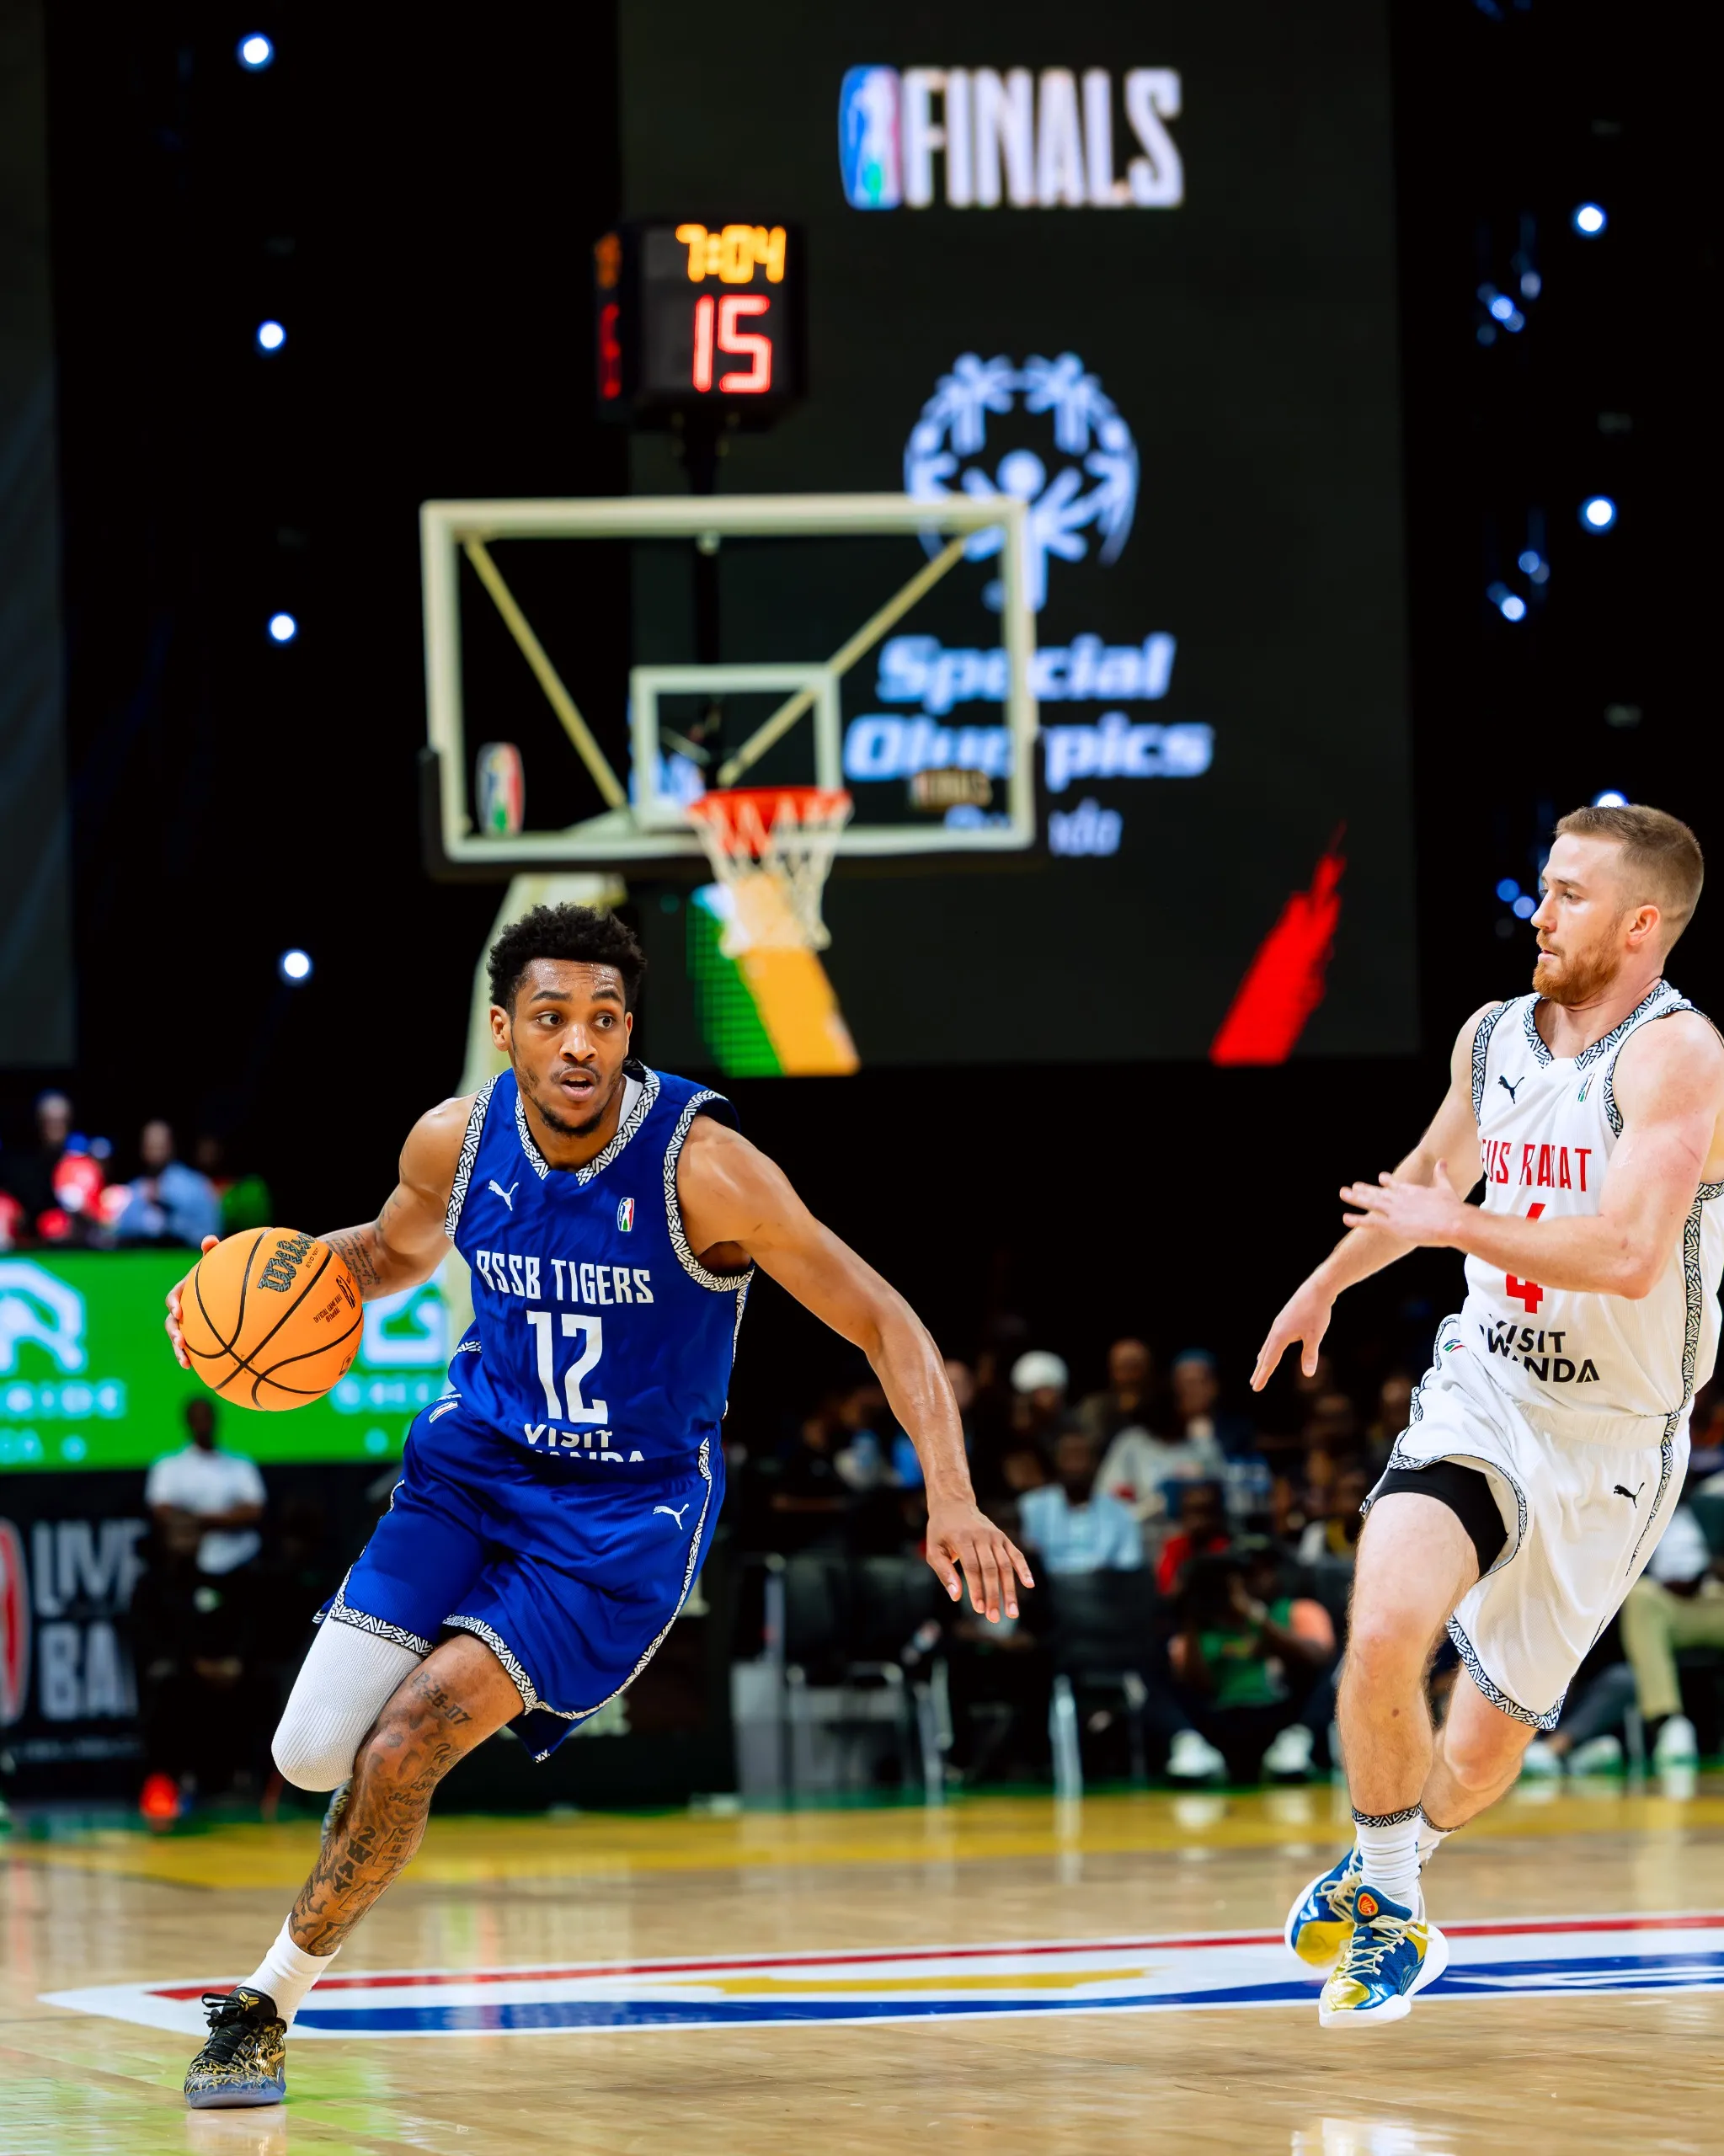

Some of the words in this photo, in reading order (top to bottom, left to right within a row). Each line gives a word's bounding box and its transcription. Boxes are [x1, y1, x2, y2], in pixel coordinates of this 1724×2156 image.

[901, 67, 1183, 209] FINALS
[675, 224, 787, 283] 7:04
[693, 295, 772, 393] 15
[477, 1250, 541, 1299] RSSB
[551, 1259, 654, 1305] TIGERS
[526, 1310, 608, 1424] 12
[1479, 1324, 1600, 1384] WNDA
[524, 1423, 613, 1449] VISIT
